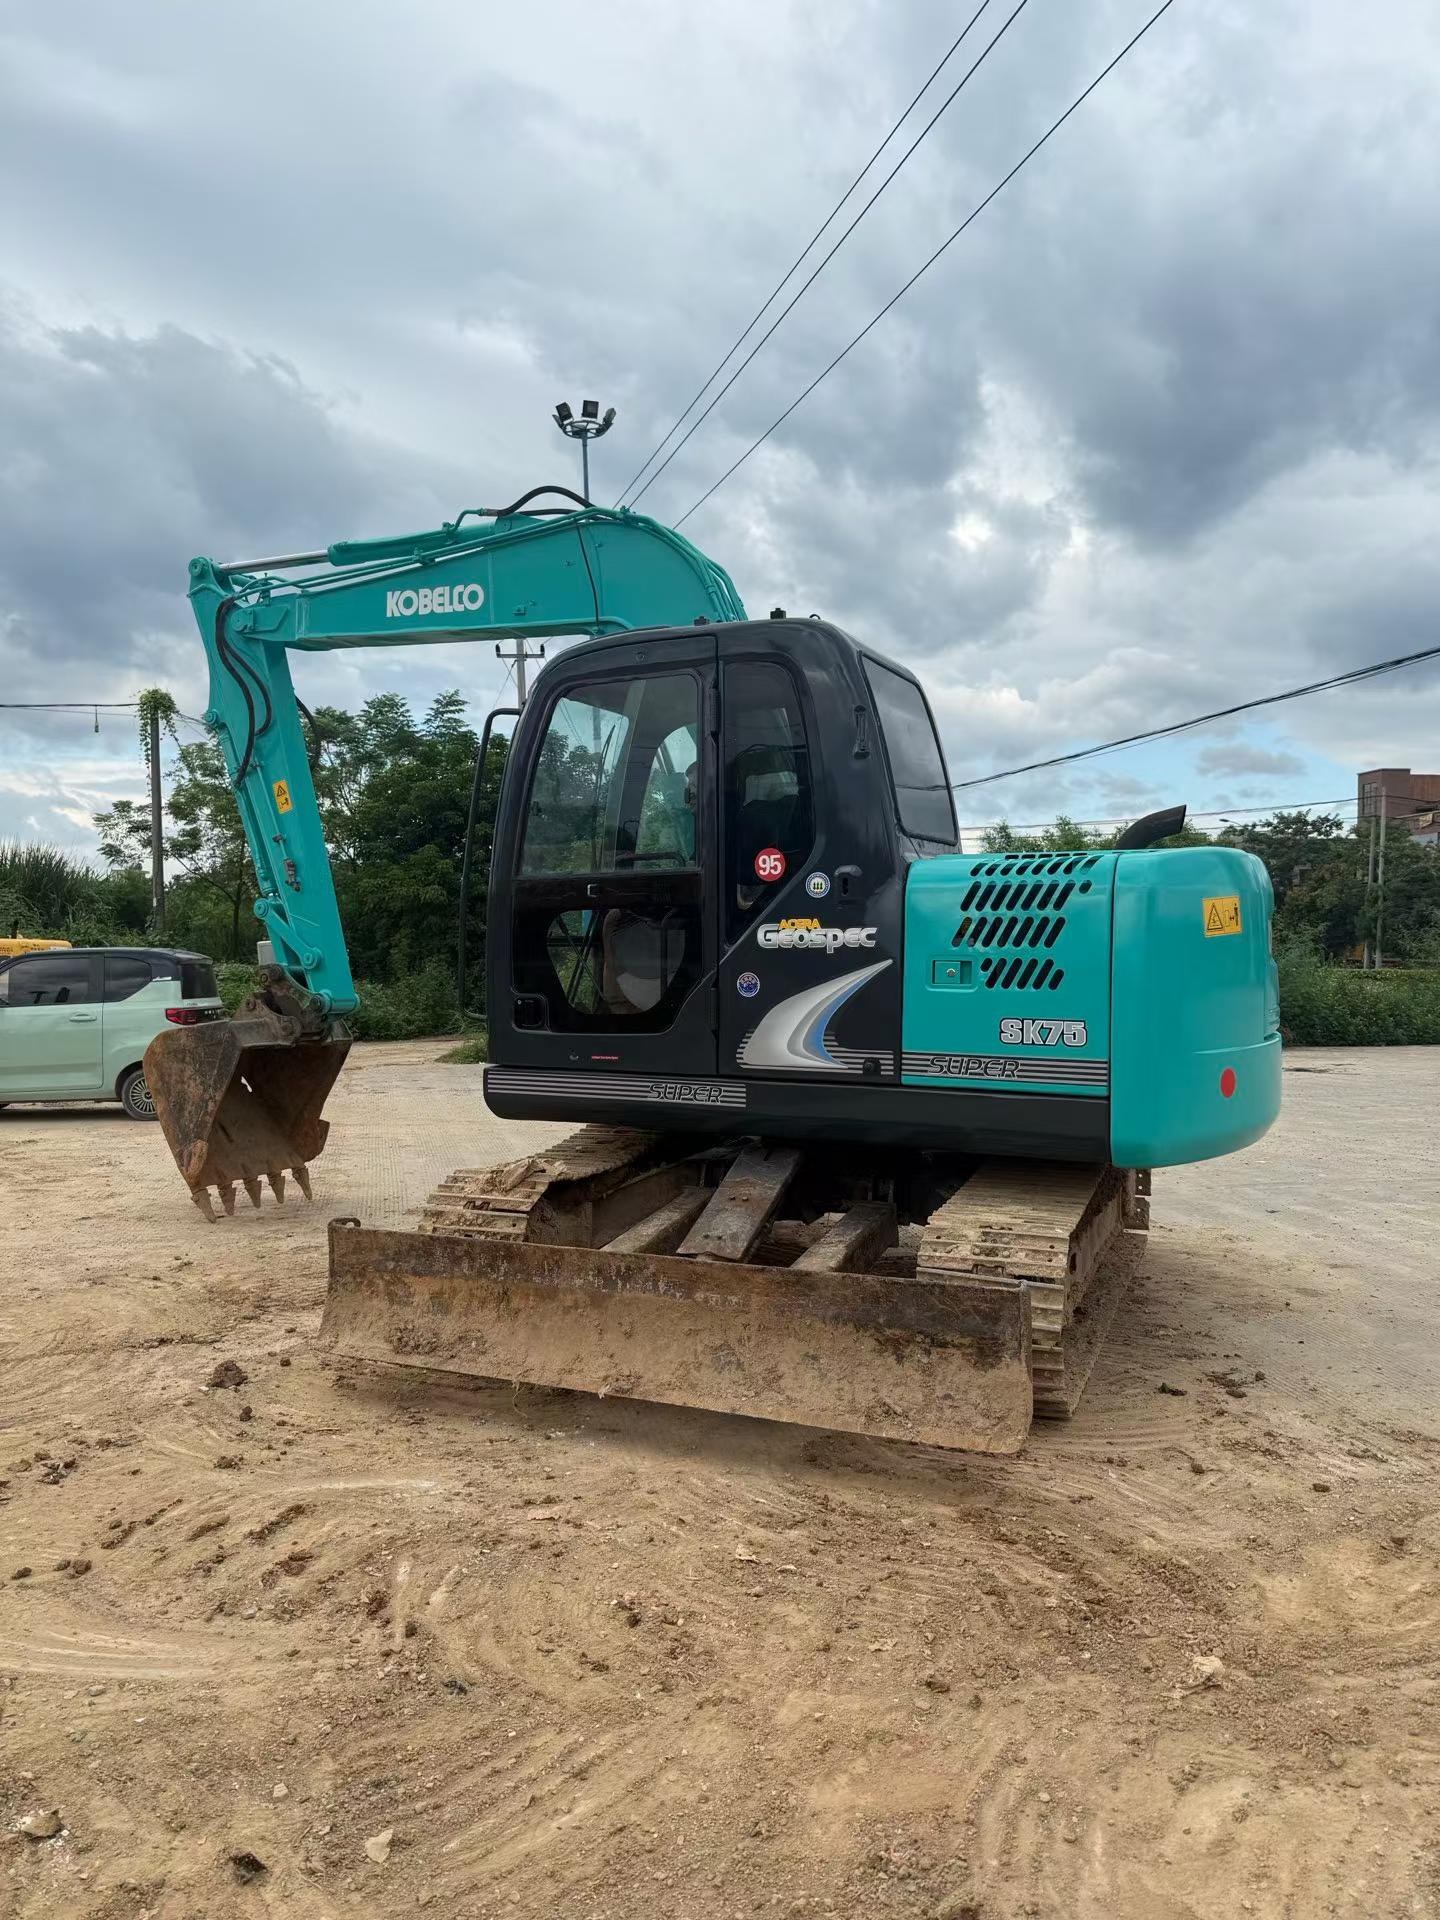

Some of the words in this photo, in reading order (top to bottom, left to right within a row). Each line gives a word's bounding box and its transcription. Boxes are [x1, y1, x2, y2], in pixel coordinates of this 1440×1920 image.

[386, 583, 484, 617] KOBELCO
[758, 855, 781, 875] 95
[1000, 1017, 1087, 1047] SK75
[927, 1056, 1020, 1079] SUPER
[648, 1083, 724, 1104] SUPER
